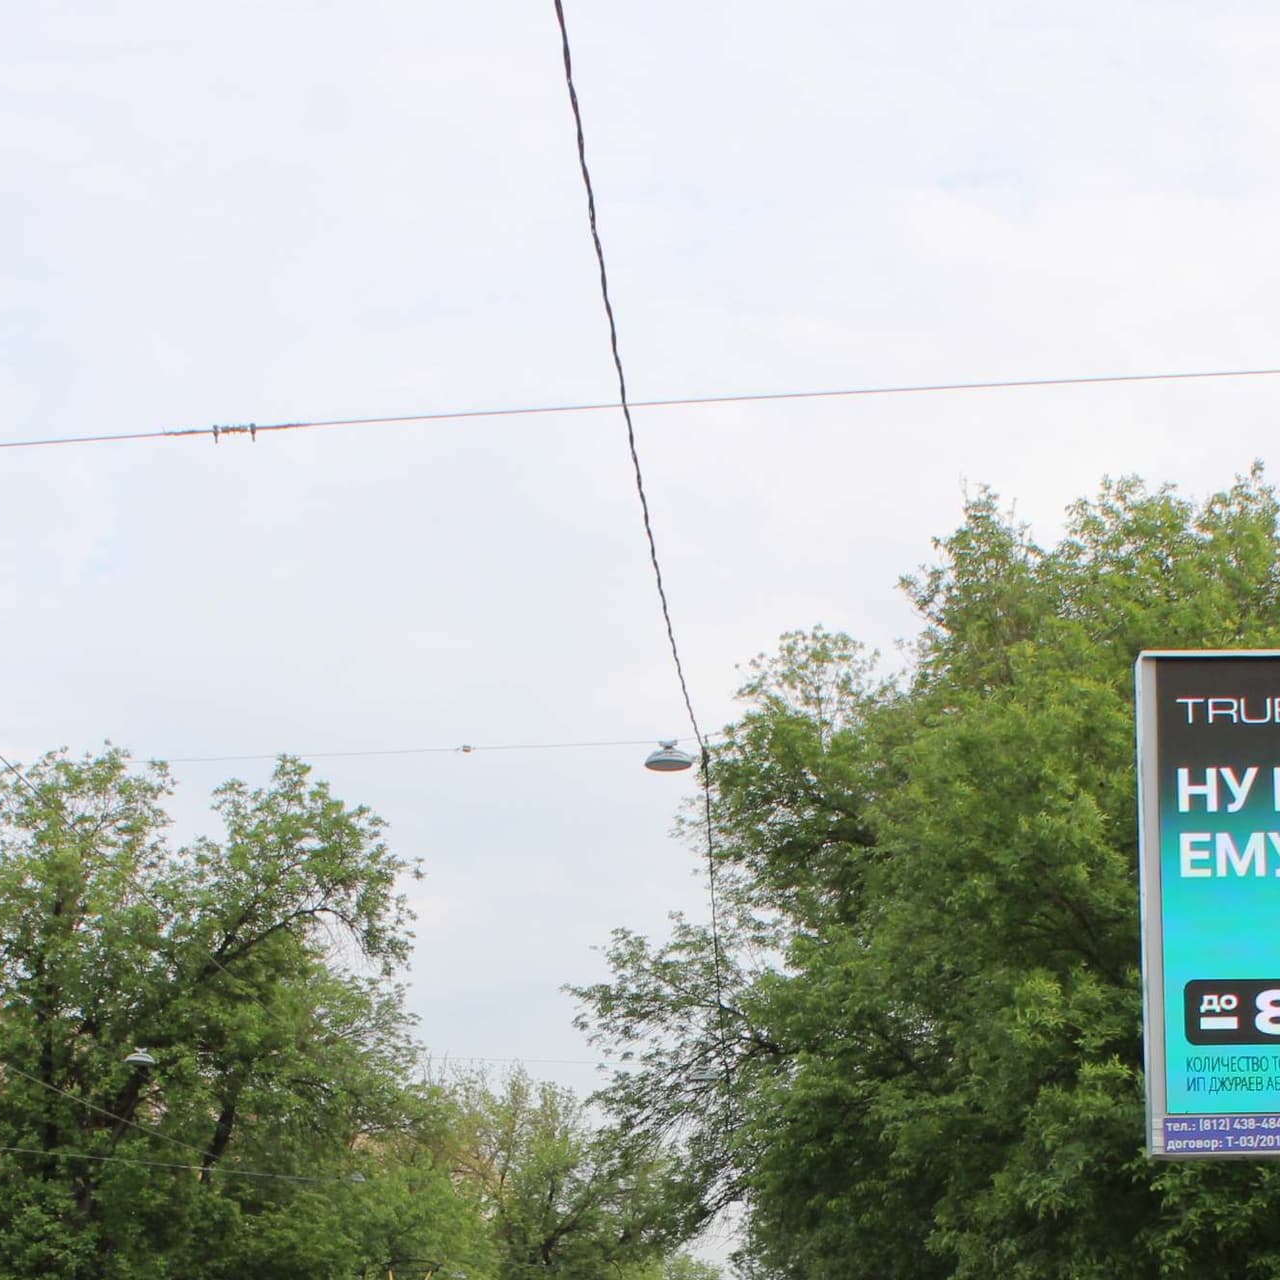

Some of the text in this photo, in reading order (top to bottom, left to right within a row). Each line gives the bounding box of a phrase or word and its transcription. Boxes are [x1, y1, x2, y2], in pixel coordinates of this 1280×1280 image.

[1177, 766, 1258, 813] НУ
[1186, 1056, 1269, 1072] КОЛИЧЕСТВО
[1186, 1077, 1206, 1092] ИП
[1208, 1076, 1264, 1095] ДЖУРАЕВ
[1166, 1122, 1196, 1132] тел.:
[1166, 1139, 1223, 1151] договор:
